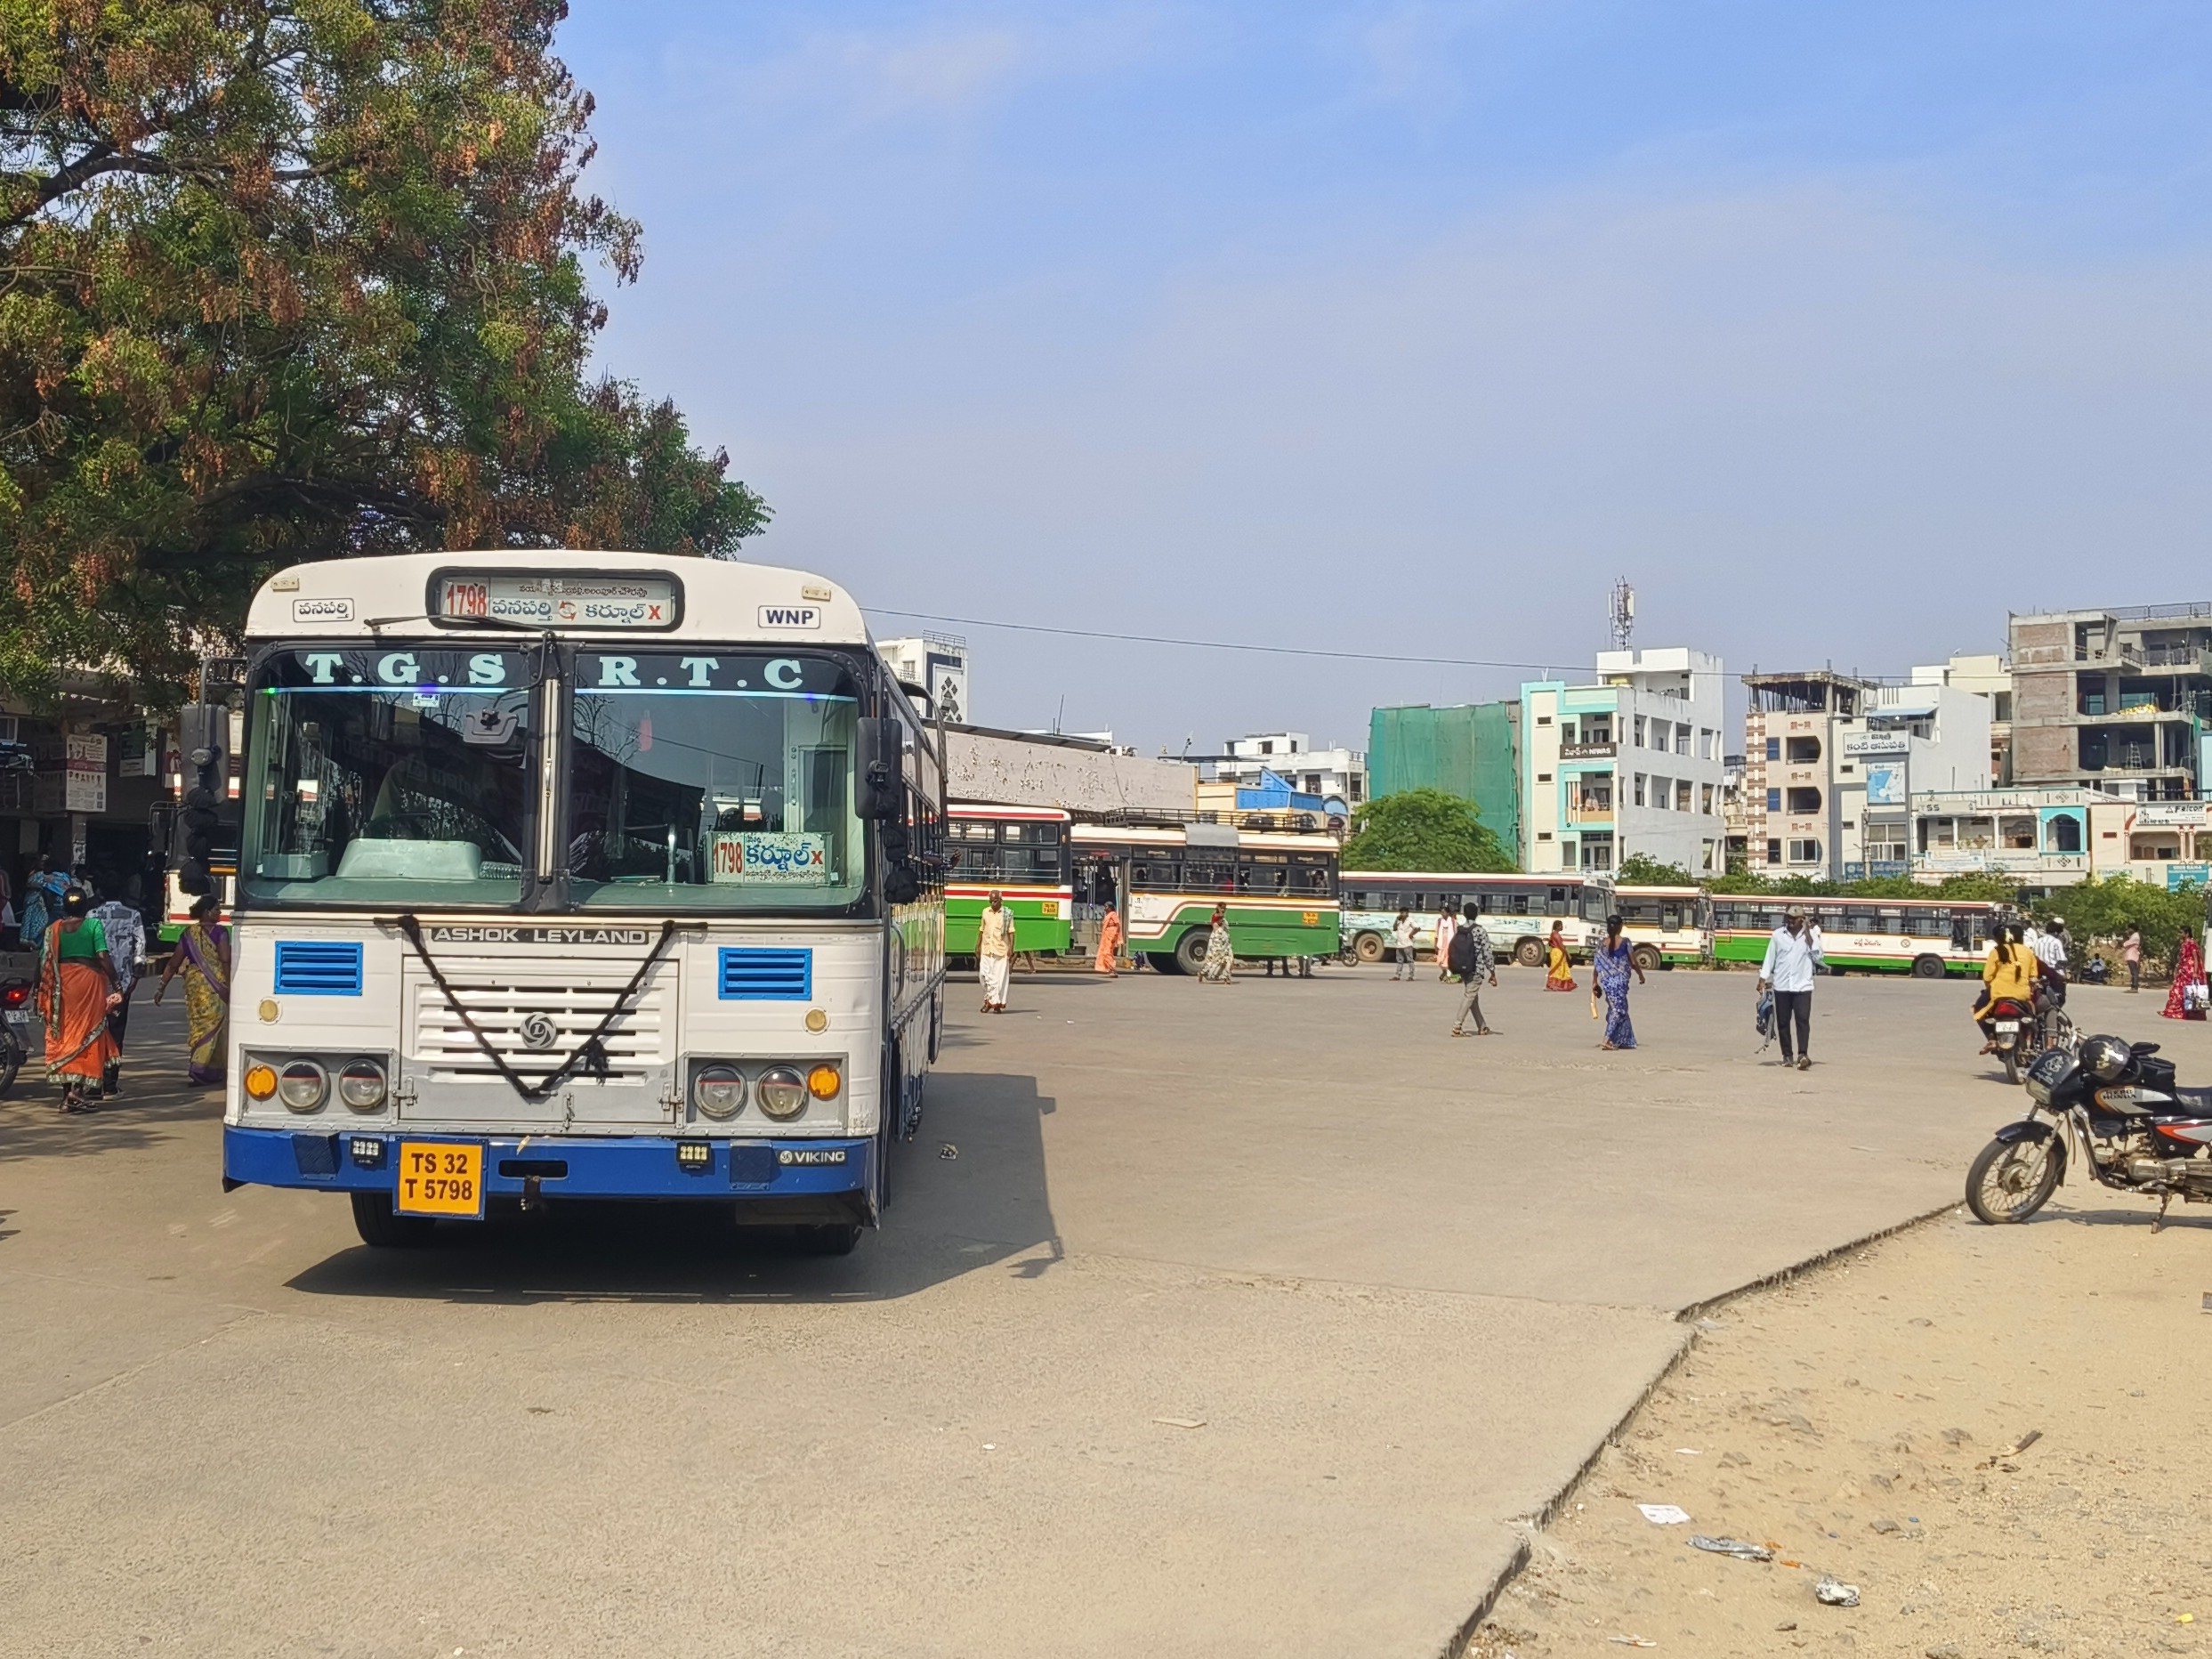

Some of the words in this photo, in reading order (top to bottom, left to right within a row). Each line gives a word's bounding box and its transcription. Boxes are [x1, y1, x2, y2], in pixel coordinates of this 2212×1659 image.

[299, 602, 350, 619] వనపర్తి
[447, 584, 488, 616] 1798
[492, 599, 553, 621] వనపర్తి
[585, 603, 646, 624] కర్నూల్
[766, 609, 814, 625] WNP
[714, 842, 743, 873] 1798
[746, 842, 811, 871] కర్నూల్
[434, 927, 520, 942] ASHOK
[534, 929, 646, 944] LEYLAND
[411, 1153, 437, 1174] TS
[444, 1153, 468, 1174] 32
[794, 1150, 845, 1163] VIKING
[405, 1178, 418, 1199] T
[424, 1179, 472, 1201] 5798
